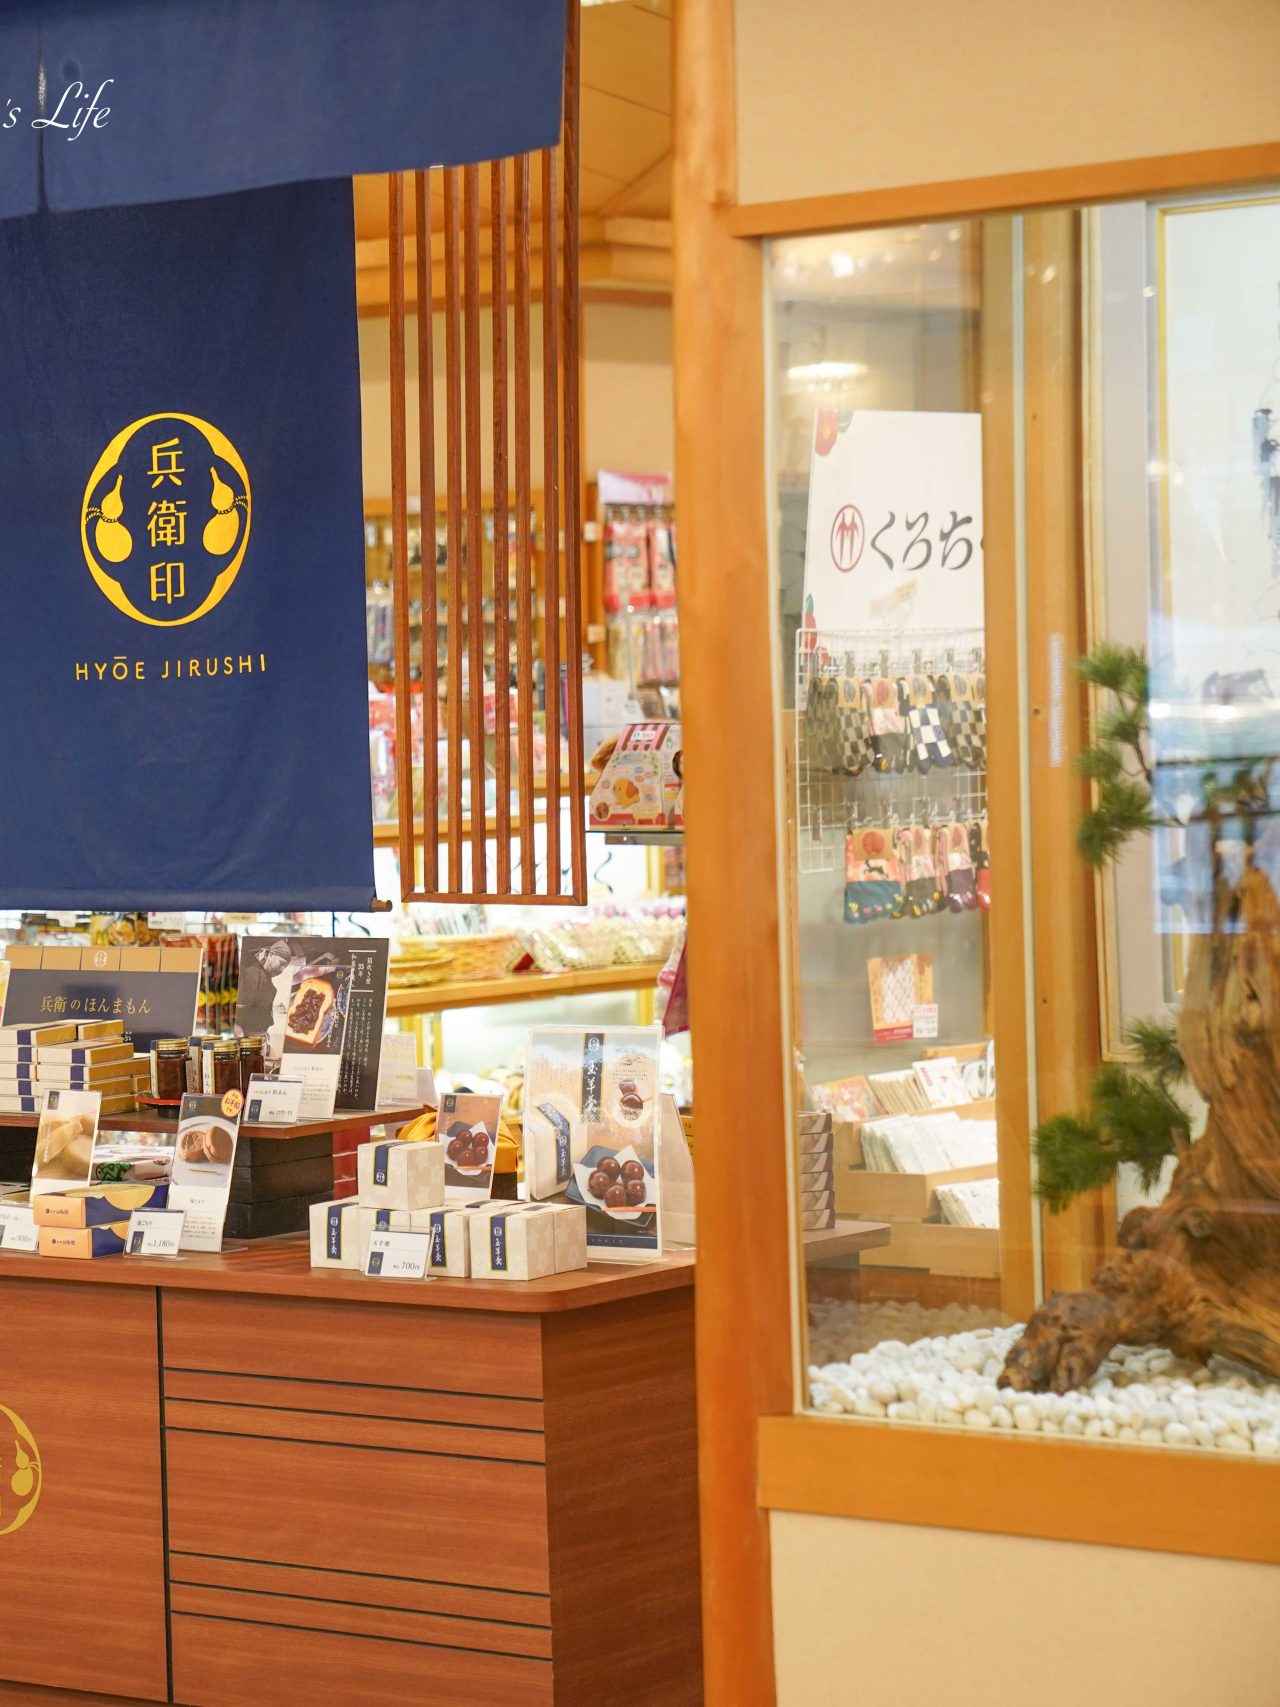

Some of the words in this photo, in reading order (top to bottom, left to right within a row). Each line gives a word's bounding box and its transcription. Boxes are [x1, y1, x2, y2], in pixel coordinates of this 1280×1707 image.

[147, 437, 188, 604] 兵衛印
[870, 510, 984, 571] くろち
[75, 655, 145, 681] HYŌE
[161, 653, 267, 679] JIRUSHI
[40, 995, 151, 1015] 兵衛のほんまもん
